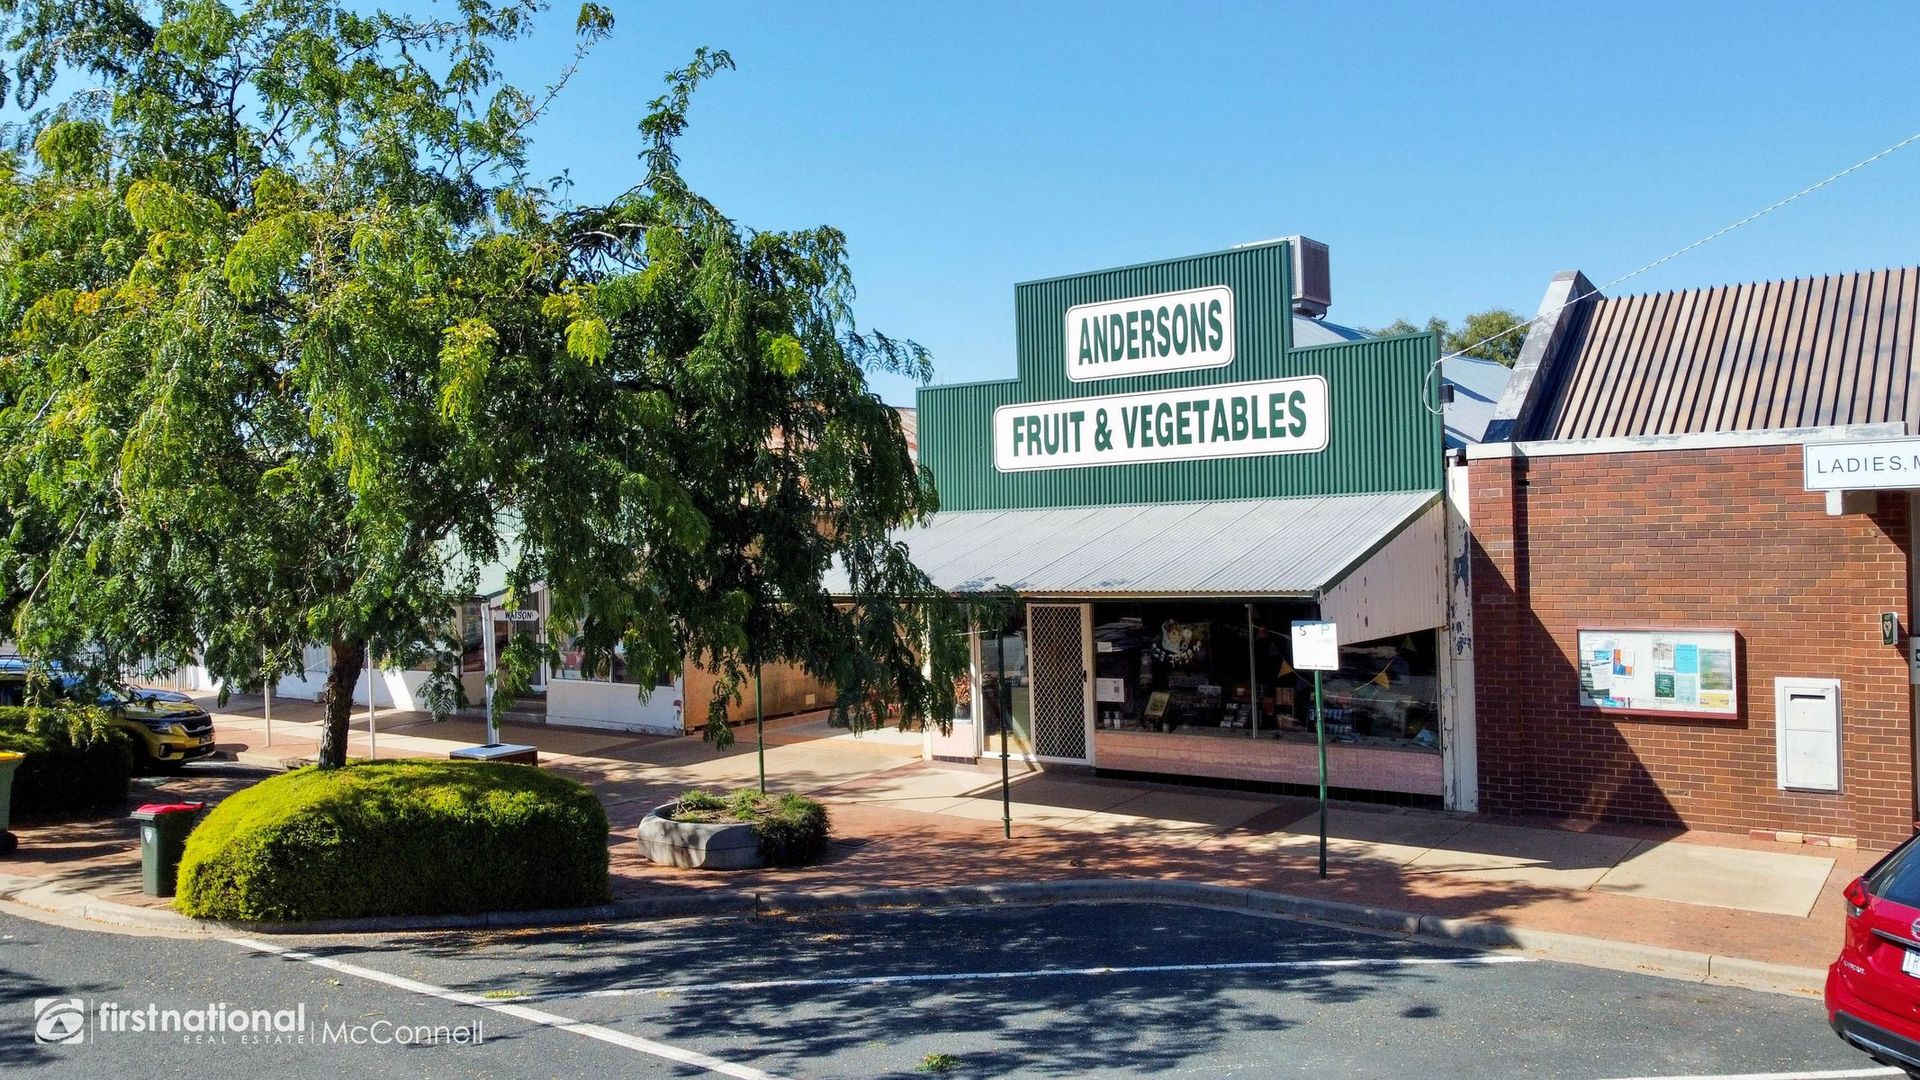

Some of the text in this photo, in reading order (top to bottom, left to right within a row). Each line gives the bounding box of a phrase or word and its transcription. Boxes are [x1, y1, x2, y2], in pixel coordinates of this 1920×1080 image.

[1078, 299, 1224, 366] ANDERSONS
[1013, 390, 1308, 458] FRUIT & VEGETABLES
[1817, 455, 1907, 474] LADIES,
